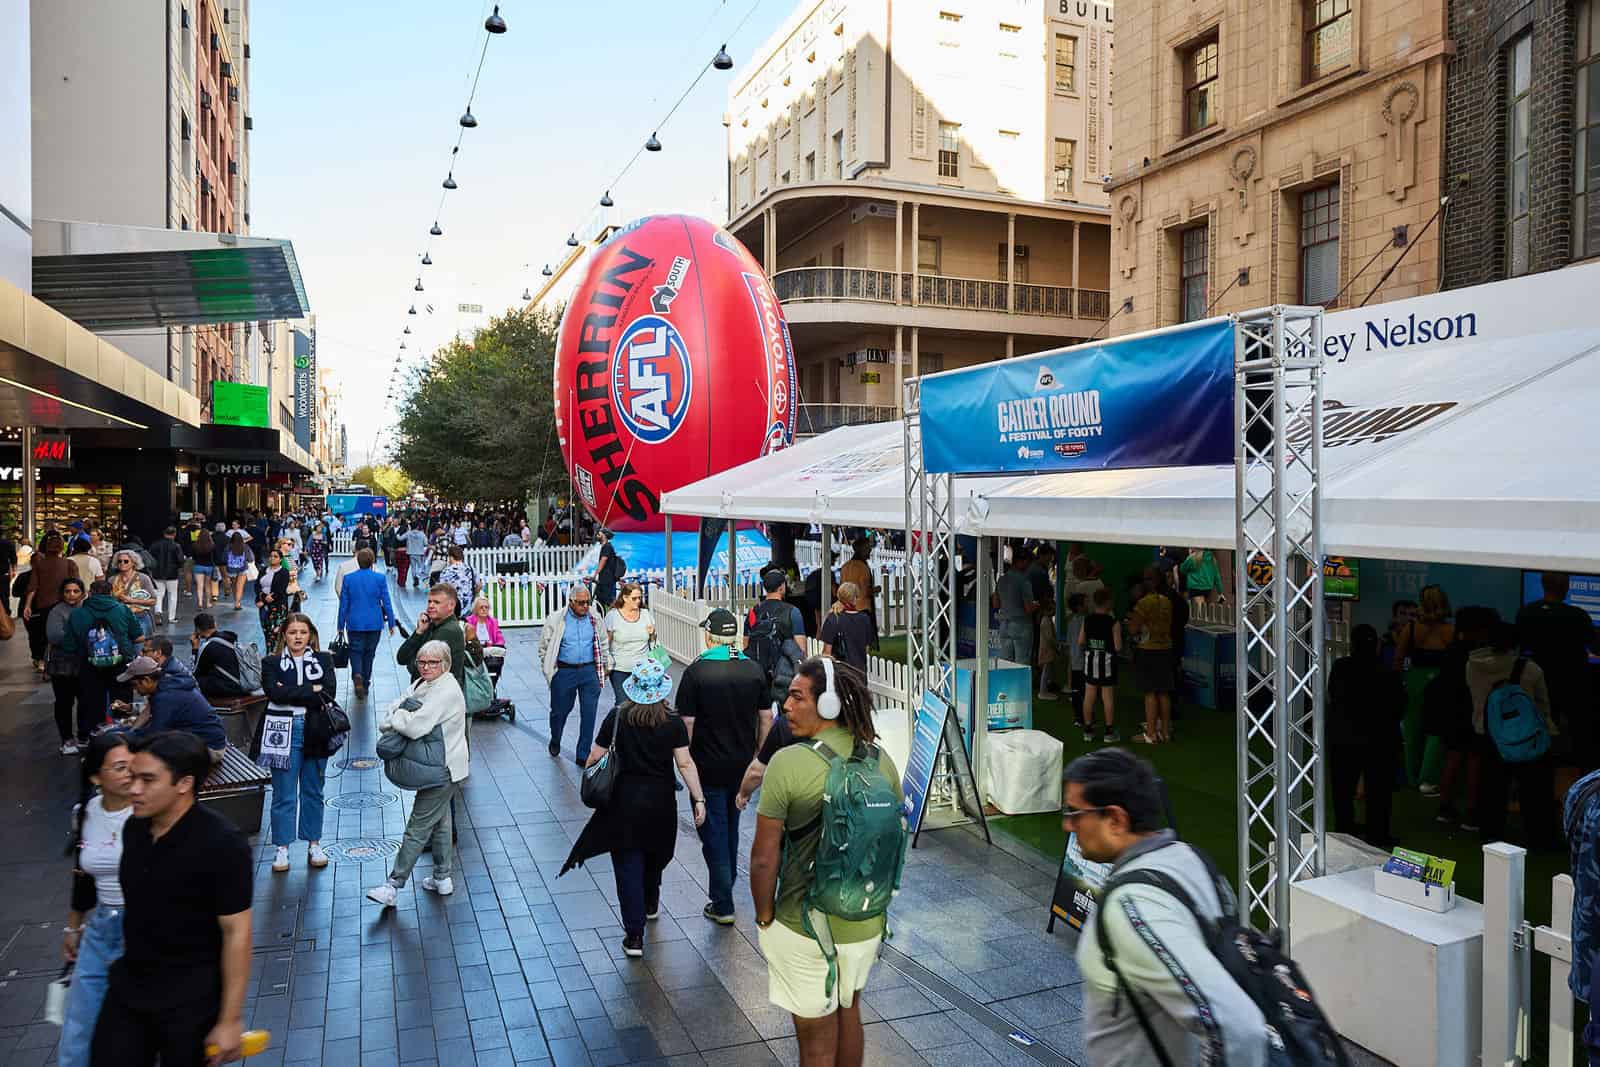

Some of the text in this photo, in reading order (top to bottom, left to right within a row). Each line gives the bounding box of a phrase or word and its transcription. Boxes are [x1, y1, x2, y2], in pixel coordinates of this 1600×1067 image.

[667, 257, 685, 287] SOUTH
[756, 281, 785, 373] TOYOTA
[1365, 312, 1477, 351] Nelson
[576, 246, 660, 521] SHERRIN
[629, 325, 671, 430] AFL
[997, 390, 1101, 433] GATHER ROUND
[34, 441, 66, 461] H&M
[999, 426, 1103, 443] A FESTIVAL OF FOOTY
[221, 464, 262, 475] HYPE
